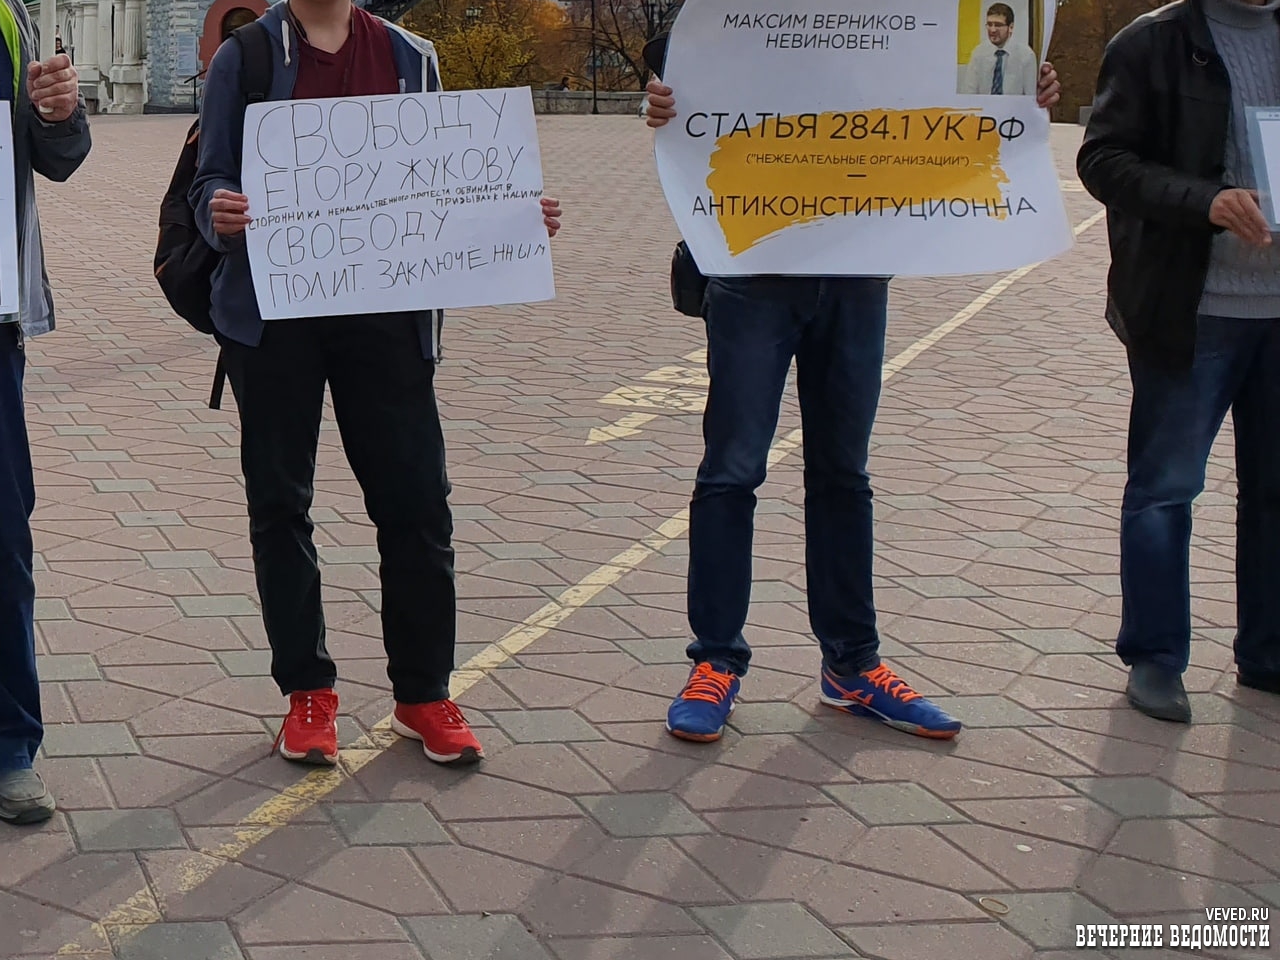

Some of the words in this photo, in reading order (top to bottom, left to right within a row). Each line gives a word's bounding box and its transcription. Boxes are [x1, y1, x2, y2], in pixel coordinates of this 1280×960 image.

[723, 13, 807, 30] МАКСИМ
[812, 14, 917, 31] ВЕРНИКОВ
[765, 33, 890, 50] НЕВИНОВЕН!
[257, 92, 506, 169] СВОБОДУ
[685, 112, 818, 139] СТАТЬЯ
[829, 113, 911, 140] 284.1
[923, 115, 968, 141] УК
[977, 116, 1025, 142] РФ
[265, 161, 382, 212] ЕГОРУ
[396, 146, 524, 190] ЖУКОВУ
[248, 212, 321, 231] СТОРОННИКА
[410, 188, 451, 200] ПРОТЕСТА
[506, 183, 513, 191] В
[692, 195, 1038, 220] АНТИКОНСТИТУЦИОННА
[267, 210, 448, 267] СВОБОДУ
[269, 264, 365, 307] ПОЛИТ.
